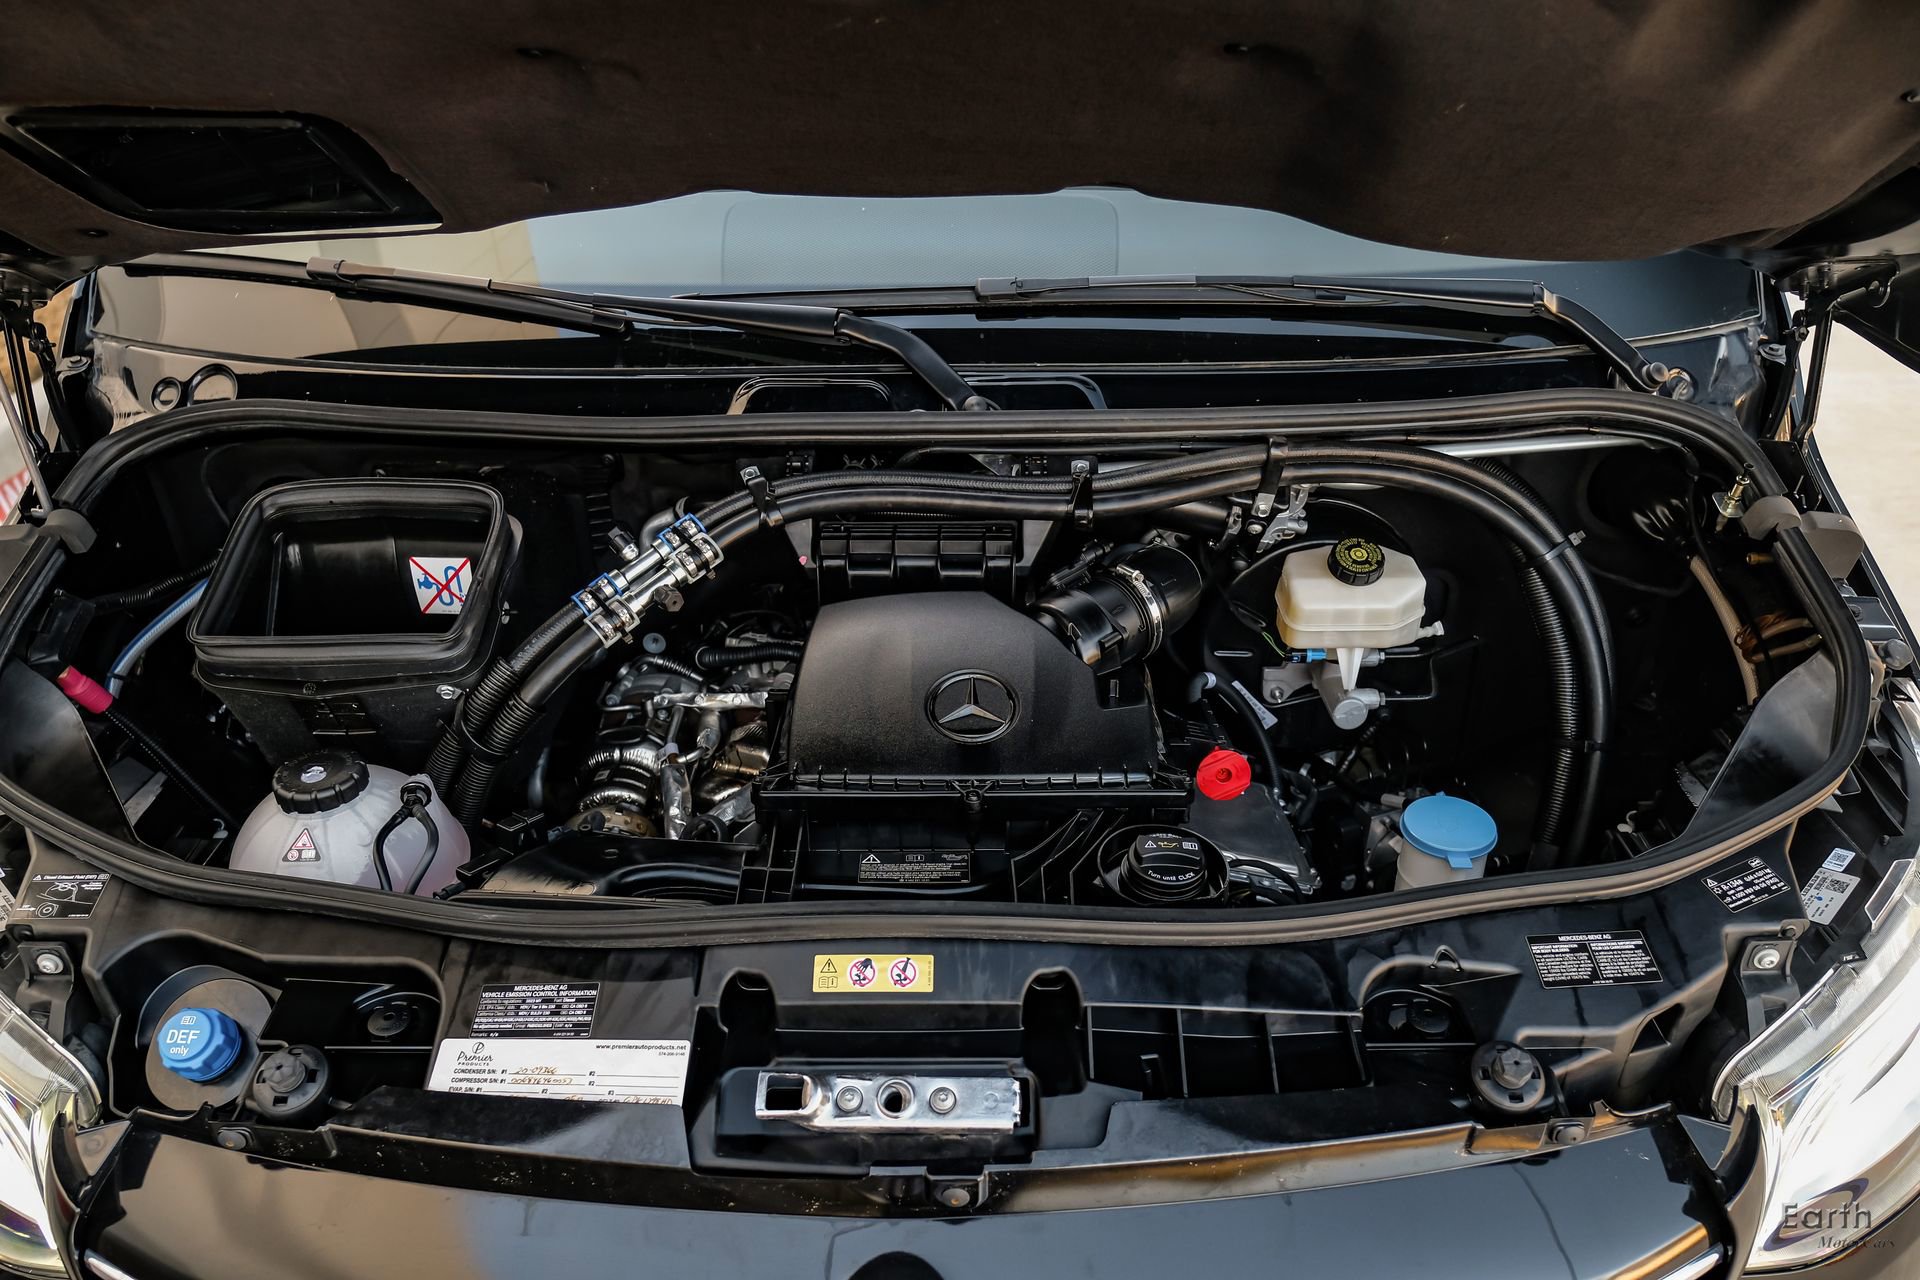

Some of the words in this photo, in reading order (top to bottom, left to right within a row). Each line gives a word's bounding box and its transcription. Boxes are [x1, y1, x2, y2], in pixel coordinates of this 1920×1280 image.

[1147, 870, 1161, 879] Turn
[1178, 872, 1195, 880] CLICK
[166, 1029, 200, 1044] DEF
[170, 1045, 189, 1056] only
[457, 1050, 493, 1062] Premier
